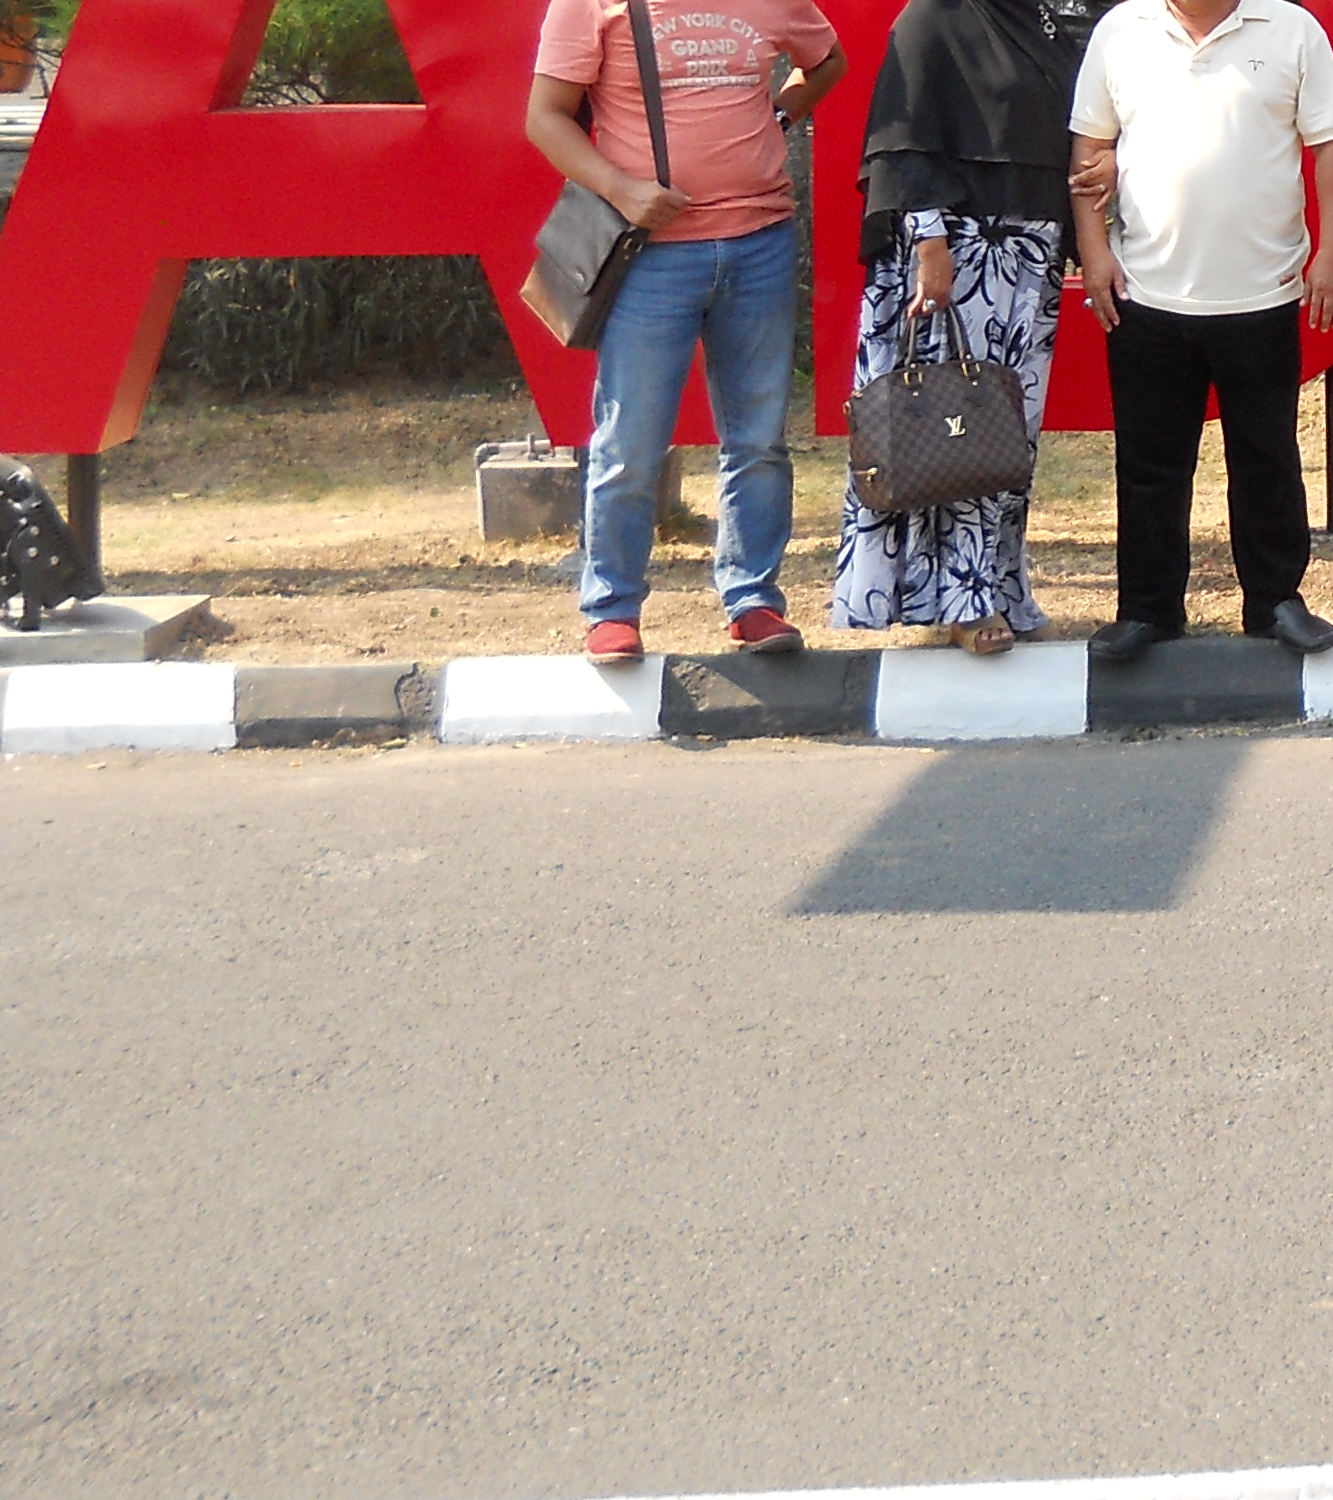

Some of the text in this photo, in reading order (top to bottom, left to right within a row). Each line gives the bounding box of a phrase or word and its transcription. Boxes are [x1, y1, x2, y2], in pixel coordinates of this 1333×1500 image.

[680, 12, 726, 29] YORK
[730, 18, 764, 46] CITY
[671, 38, 739, 57] GRAND
[685, 60, 729, 76] PRIX
